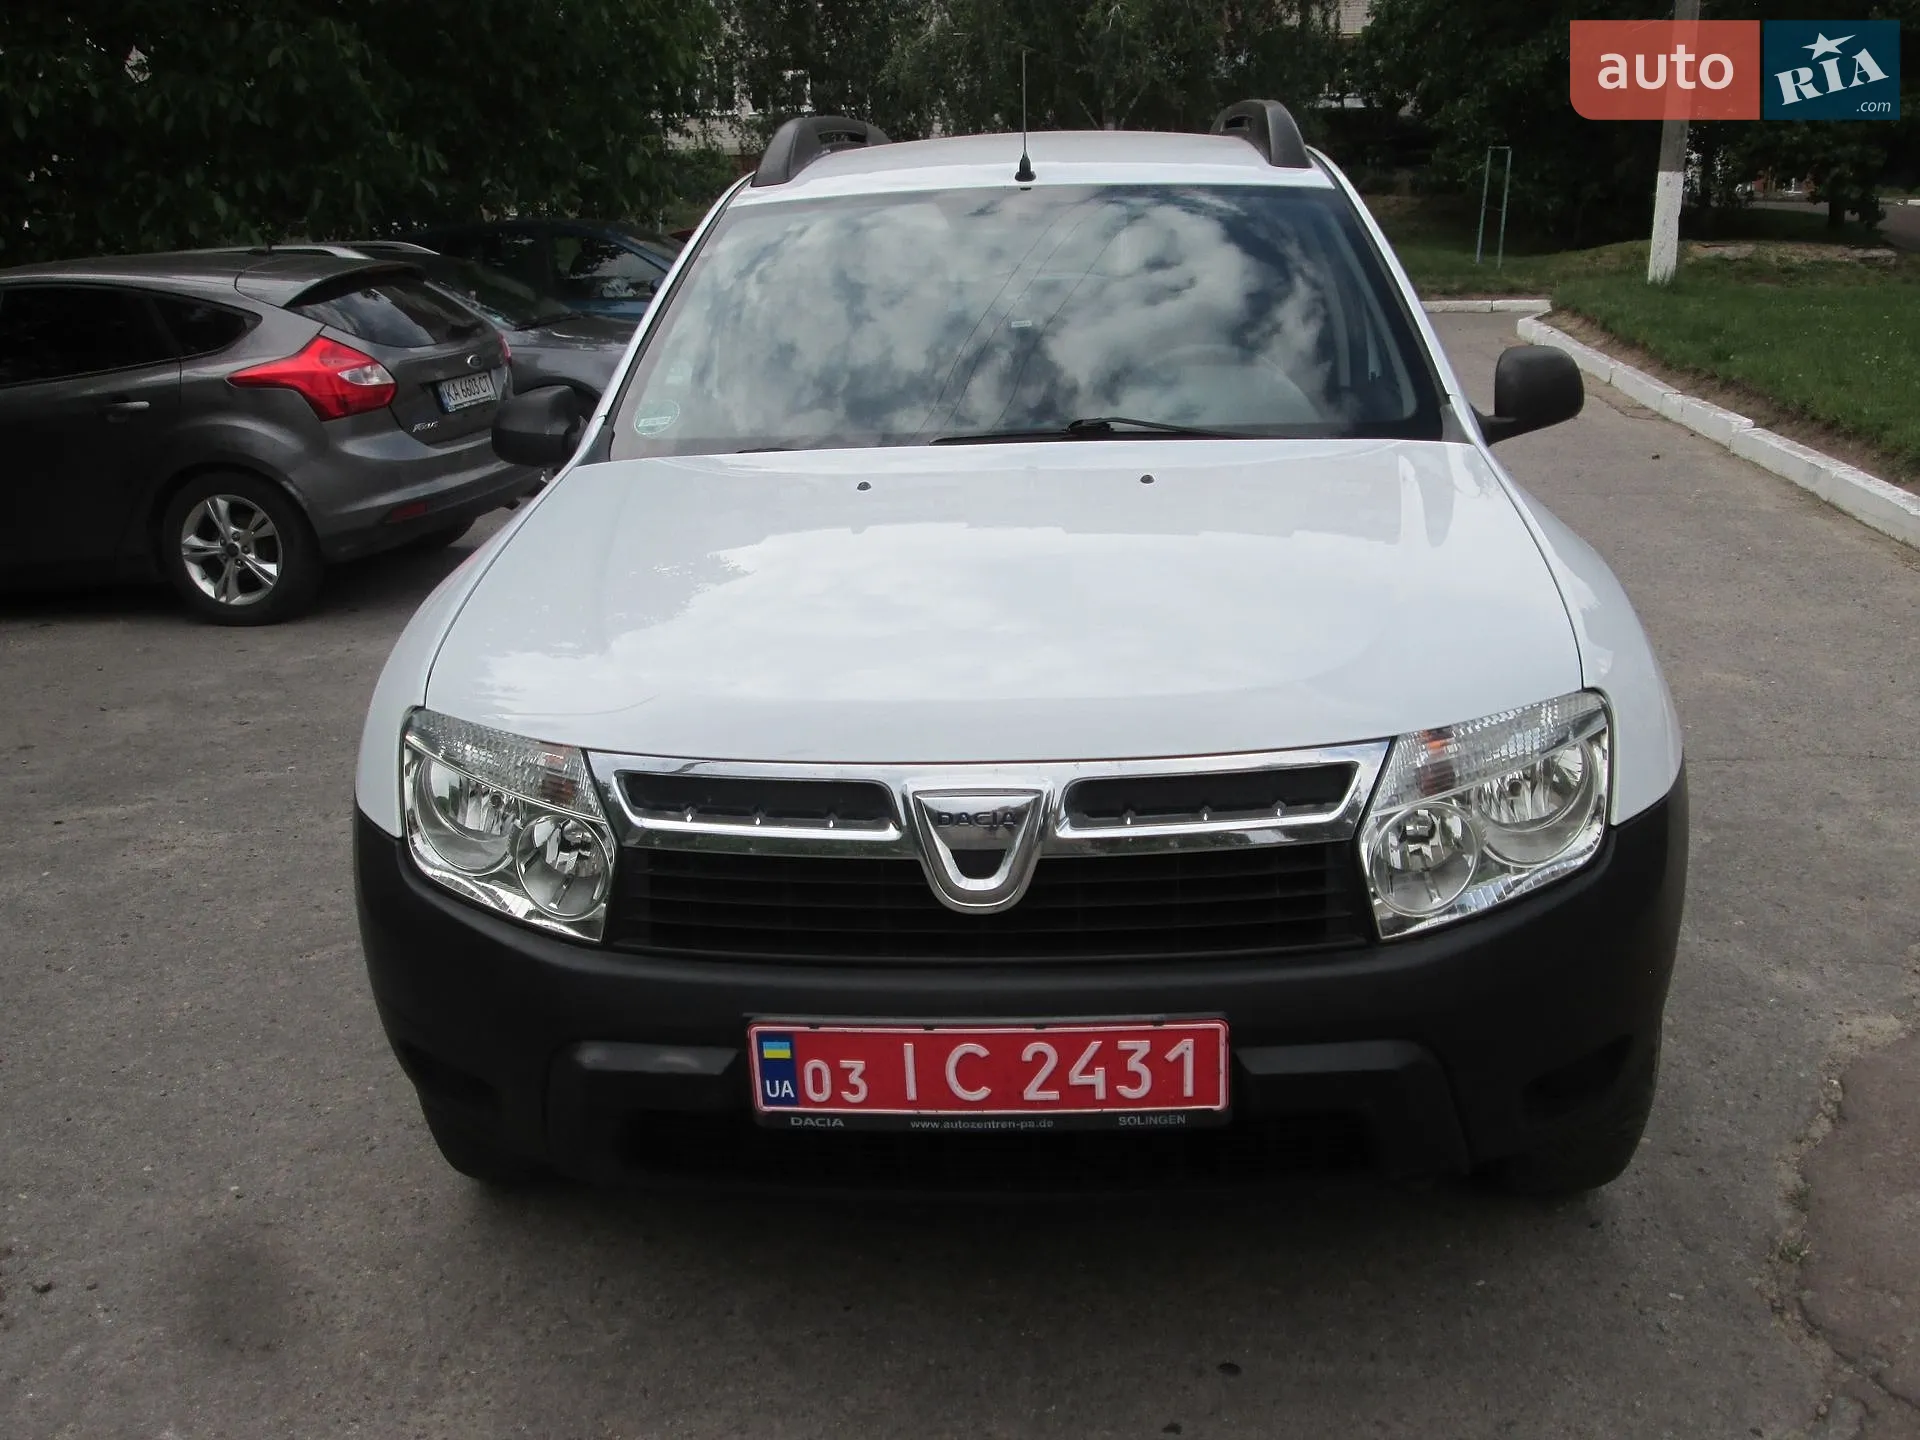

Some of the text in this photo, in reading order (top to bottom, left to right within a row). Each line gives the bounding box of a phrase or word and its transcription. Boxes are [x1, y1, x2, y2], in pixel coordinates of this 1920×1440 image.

[445, 382, 461, 402] KA
[937, 811, 1018, 828] DACIA
[804, 1058, 868, 1104] 03
[1020, 1038, 1195, 1102] 2431
[766, 1080, 795, 1099] UA
[790, 1116, 845, 1128] DACIA
[1118, 1113, 1187, 1127] SOLINGEN
